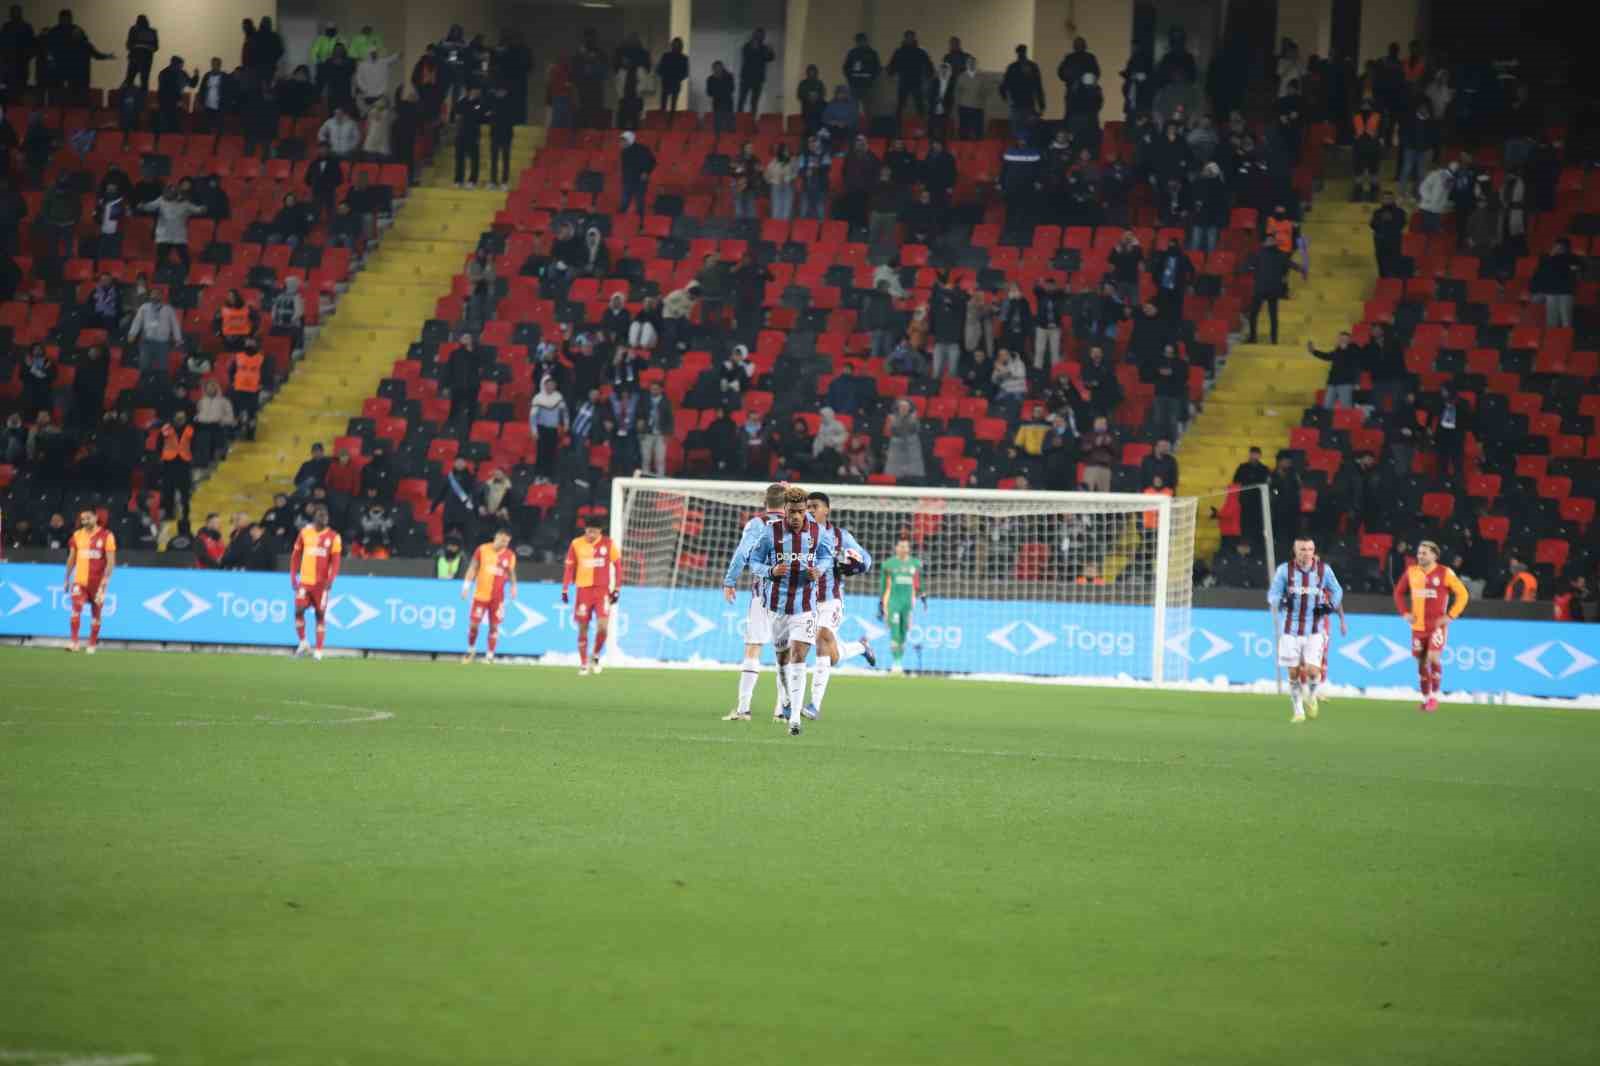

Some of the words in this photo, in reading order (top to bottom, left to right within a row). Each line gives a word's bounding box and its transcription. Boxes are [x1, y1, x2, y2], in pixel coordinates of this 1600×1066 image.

[216, 591, 288, 624] Togg
[384, 597, 457, 630] Togg
[906, 624, 962, 649] ogg
[1061, 623, 1136, 656] Togg
[1238, 631, 1273, 658] To
[1441, 646, 1497, 672] ogg
